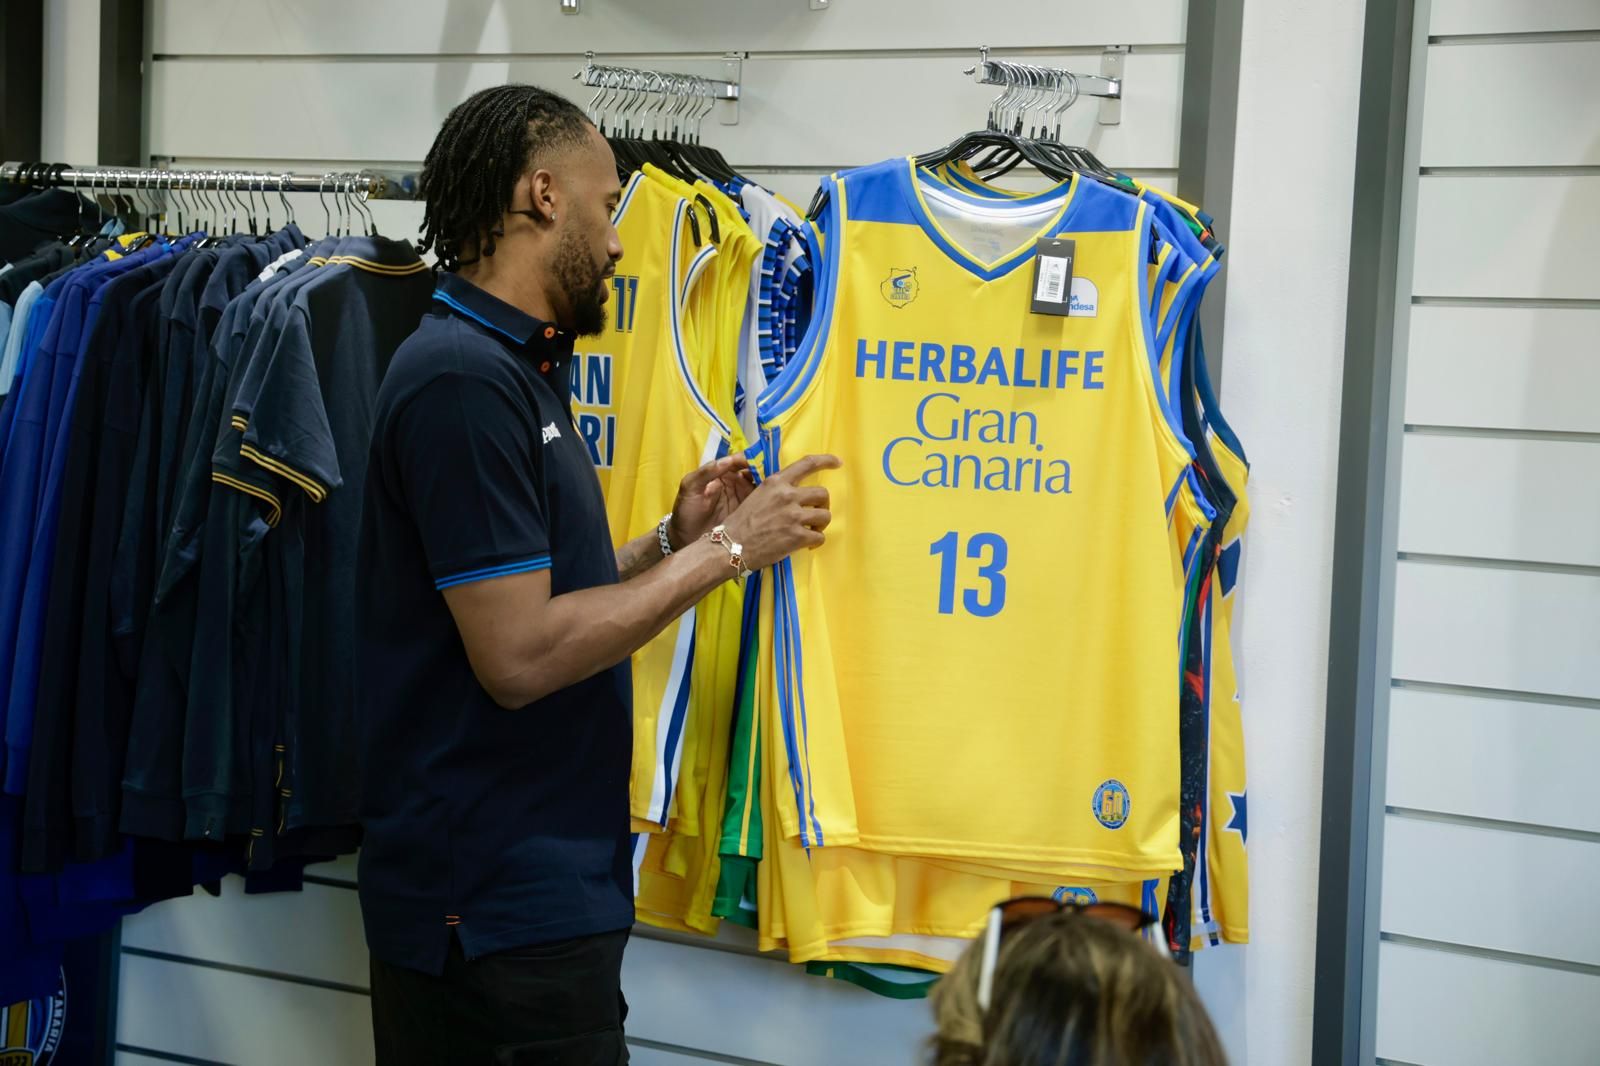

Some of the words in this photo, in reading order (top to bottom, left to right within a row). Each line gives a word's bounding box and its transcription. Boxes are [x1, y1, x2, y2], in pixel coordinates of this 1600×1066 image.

[855, 338, 1105, 390] HERBALIFE
[915, 392, 1037, 445] Gran
[881, 436, 1073, 495] Canaria
[929, 530, 1009, 618] 13
